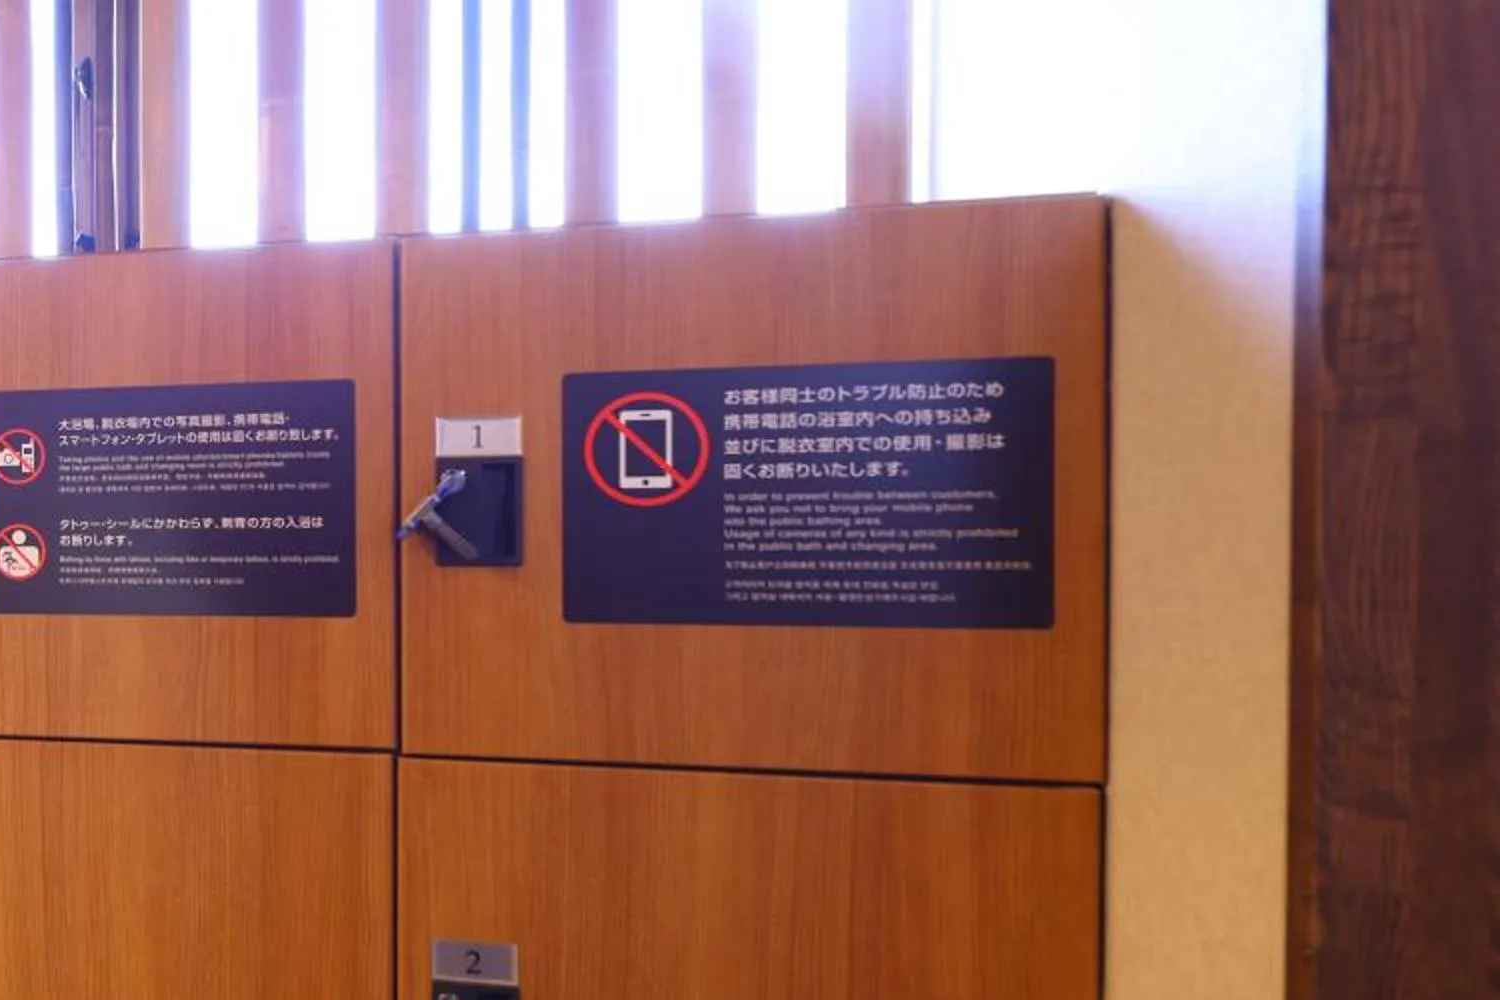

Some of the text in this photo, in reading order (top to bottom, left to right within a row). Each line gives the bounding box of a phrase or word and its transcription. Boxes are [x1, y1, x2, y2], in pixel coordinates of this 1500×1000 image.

[724, 382, 1004, 405] お客様同士のトラブル防止のため
[724, 407, 992, 431] 携帯電話の浴室内への持ち込み
[471, 424, 484, 449] 1
[724, 461, 910, 480] 固くお断りいたします。
[464, 949, 482, 975] 2
